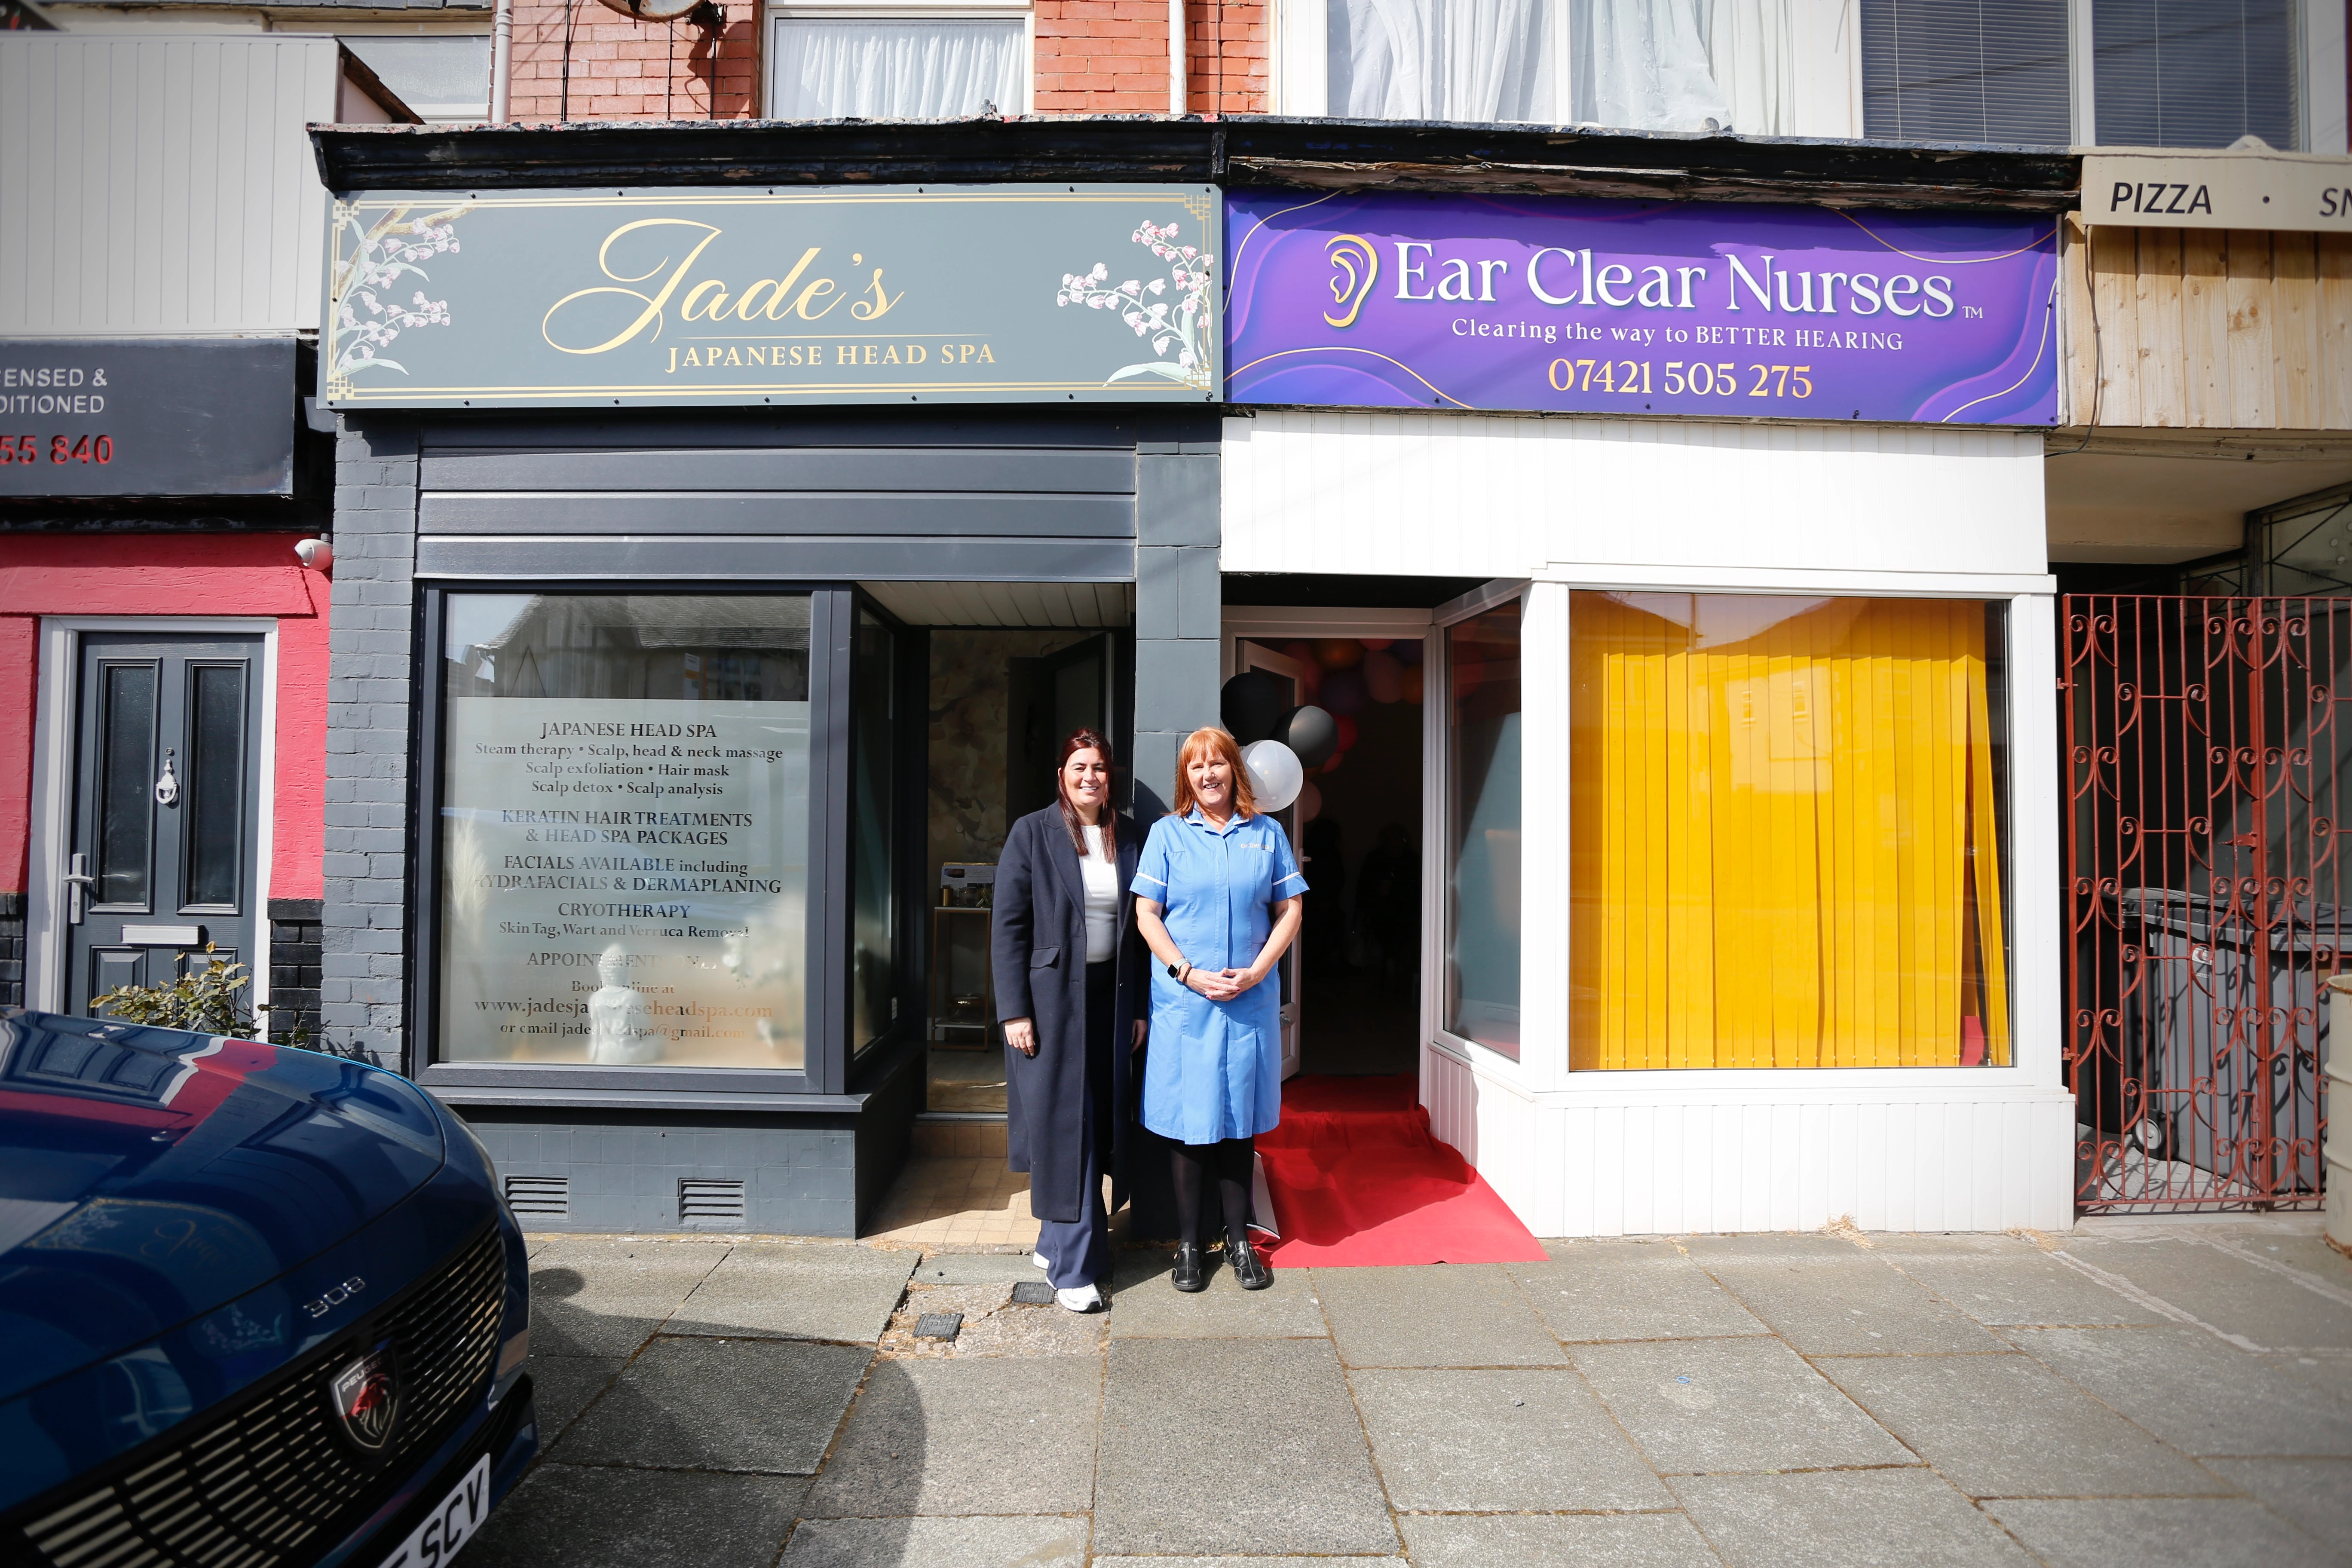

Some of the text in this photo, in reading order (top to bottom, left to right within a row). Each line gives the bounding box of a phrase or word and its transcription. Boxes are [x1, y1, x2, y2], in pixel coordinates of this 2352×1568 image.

[2110, 182, 2212, 214] PIZZA
[542, 218, 905, 354] Jade's
[1393, 242, 1508, 302] Ear
[1526, 247, 1707, 309] Clear
[1724, 254, 1955, 318] Nurses
[1452, 318, 1903, 350] Clearing the way to BETTER HEARING
[665, 344, 996, 373] JAPANESE HEAD SPA
[0, 367, 107, 387] ENSED &
[1548, 358, 1813, 398] 07421 505 275
[50, 434, 113, 465] 840
[540, 722, 717, 739] JAPANESE HEAD SPA
[475, 743, 783, 763] Steam therapy Scalp, head & neck massage
[526, 762, 729, 777] Scalp exfoliation Hair mask
[532, 781, 723, 799] Scalp detox Scalp analysis
[502, 810, 752, 827] KERATIN HAIR TREATMENTS
[526, 828, 728, 846] & HEAD SPA PACKAGES
[504, 856, 748, 877] FACIALS AVAILABLE including
[613, 876, 627, 891] &
[633, 877, 781, 894] DERMAPLANING
[558, 902, 691, 919] CRYOTHERAPY
[499, 922, 530, 934] Skin
[532, 923, 560, 939] Tag,
[563, 923, 596, 936] Wart
[600, 924, 626, 936] and
[629, 924, 683, 938] Verruca
[662, 984, 676, 995] at
[500, 1024, 517, 1034] or
[303, 1276, 367, 1319] 308
[341, 1353, 389, 1393] PEUGEO
